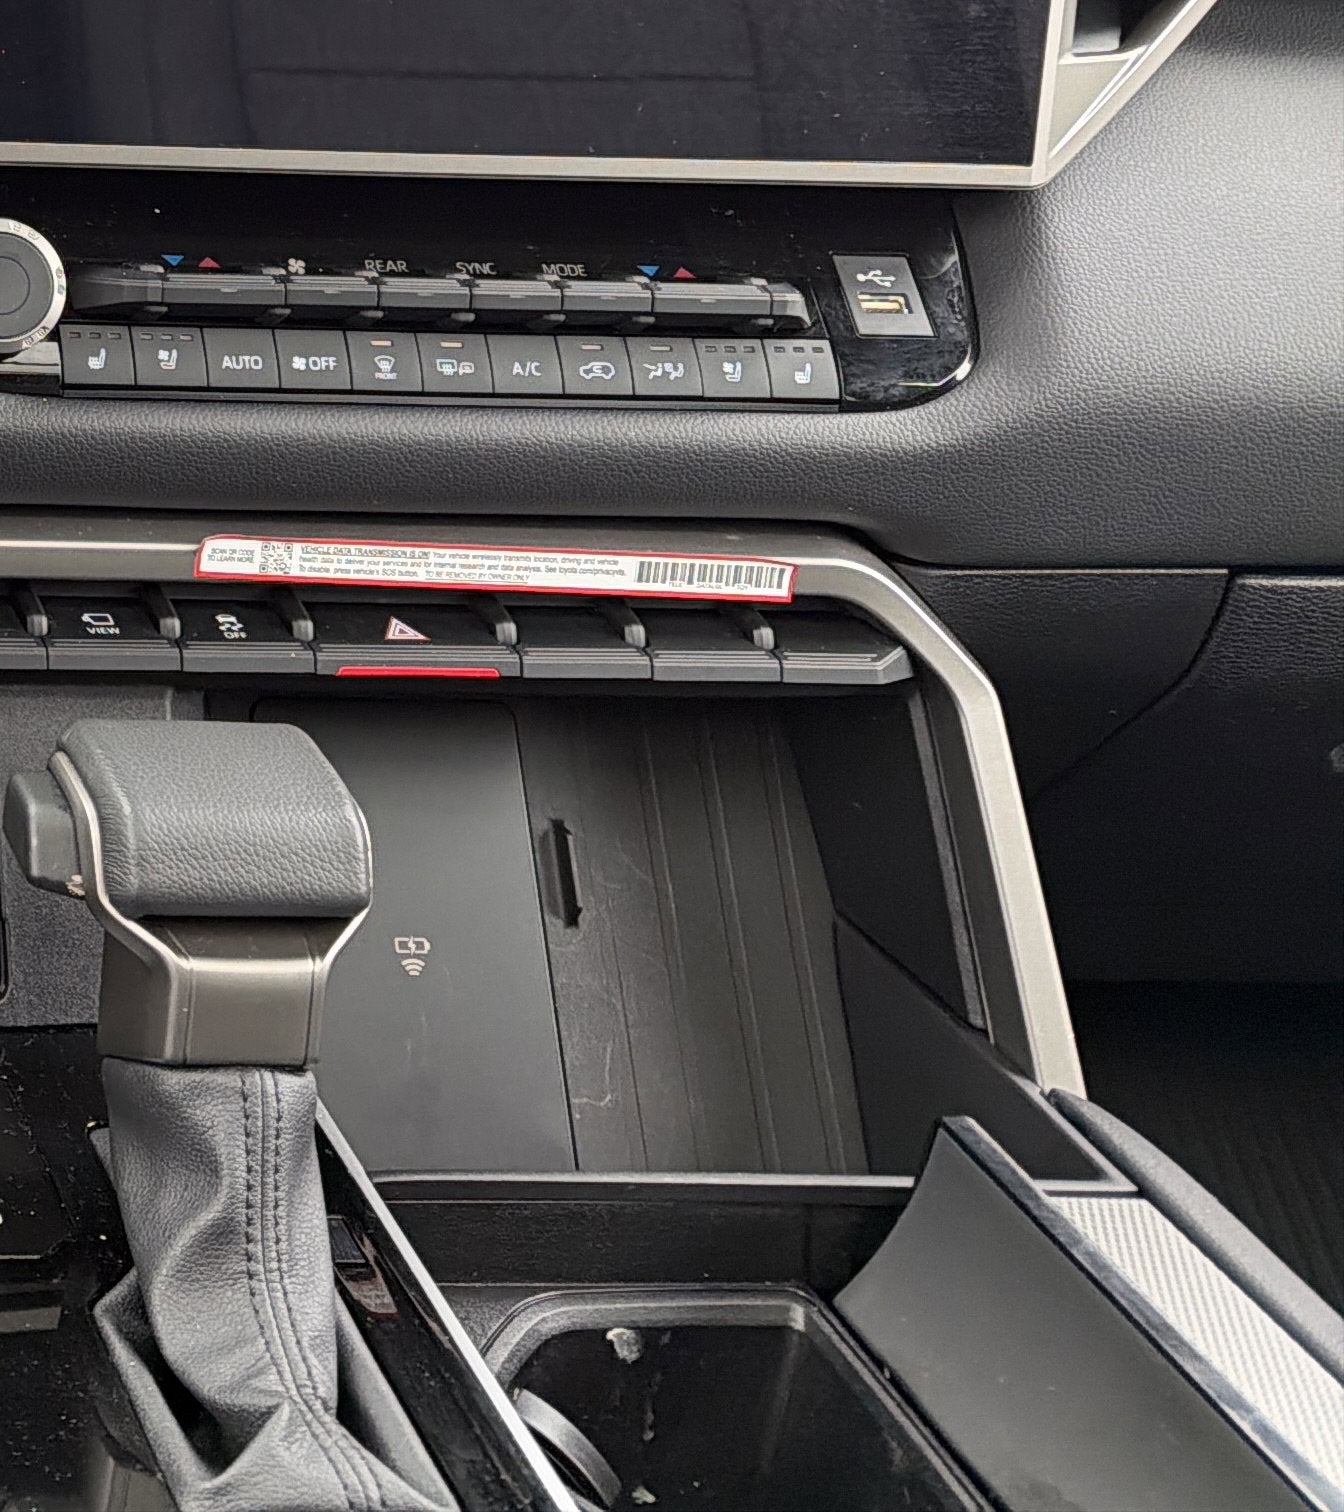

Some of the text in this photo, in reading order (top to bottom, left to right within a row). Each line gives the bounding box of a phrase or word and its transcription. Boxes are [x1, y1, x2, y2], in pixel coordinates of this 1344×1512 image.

[364, 259, 409, 273] REAR
[455, 261, 498, 275] SYNC
[542, 263, 589, 277] MODE
[221, 355, 263, 371] AUTO
[308, 356, 338, 371] OFF
[512, 361, 543, 378] A/C
[374, 372, 398, 381] FRONT
[301, 546, 331, 554] VEHICLE
[333, 547, 351, 555] DATA
[86, 626, 121, 635] VIEW
[223, 631, 248, 639] OFF
